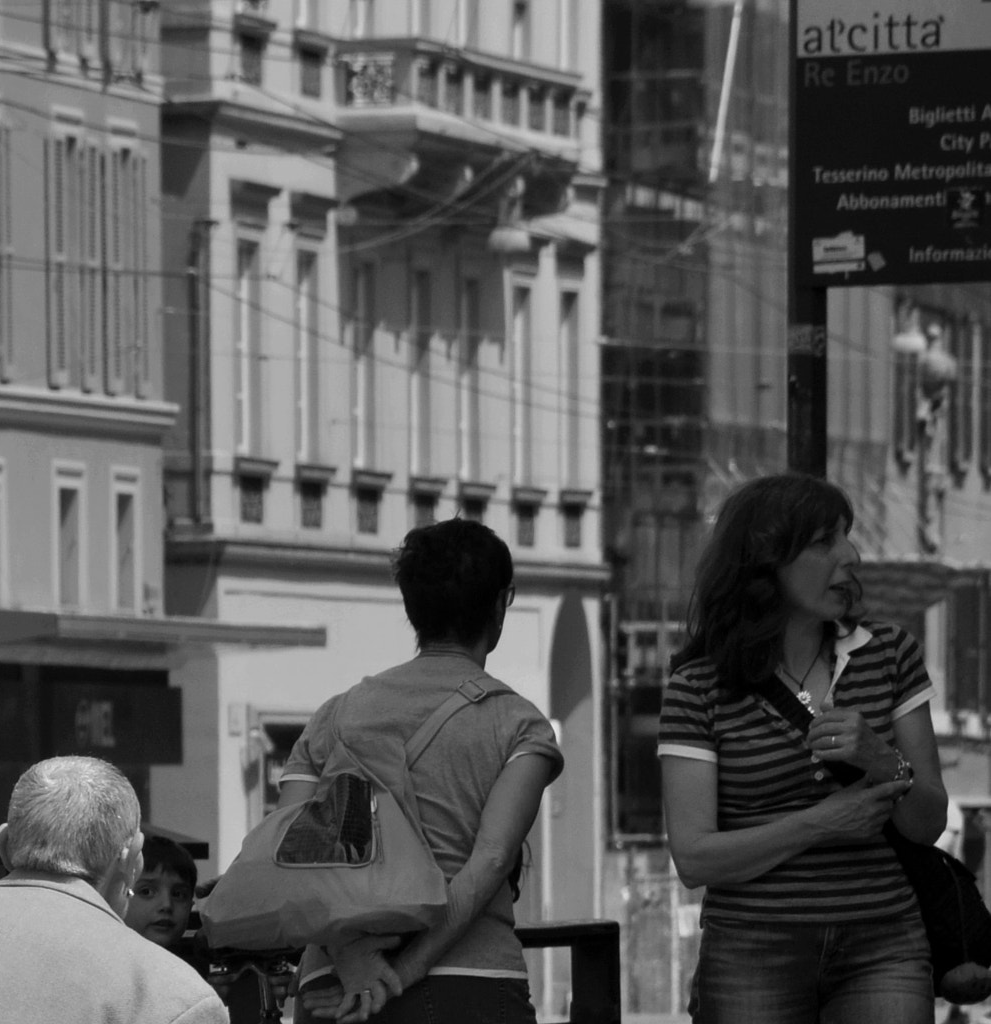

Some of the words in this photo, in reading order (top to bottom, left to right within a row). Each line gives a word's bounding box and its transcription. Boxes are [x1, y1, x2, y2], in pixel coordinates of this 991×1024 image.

[804, 61, 835, 88] Re
[846, 58, 910, 87] Enzo
[908, 104, 976, 128] Biglietti
[939, 133, 974, 155] City
[812, 164, 889, 184] Tesserino
[836, 190, 947, 211] Abbonamenti
